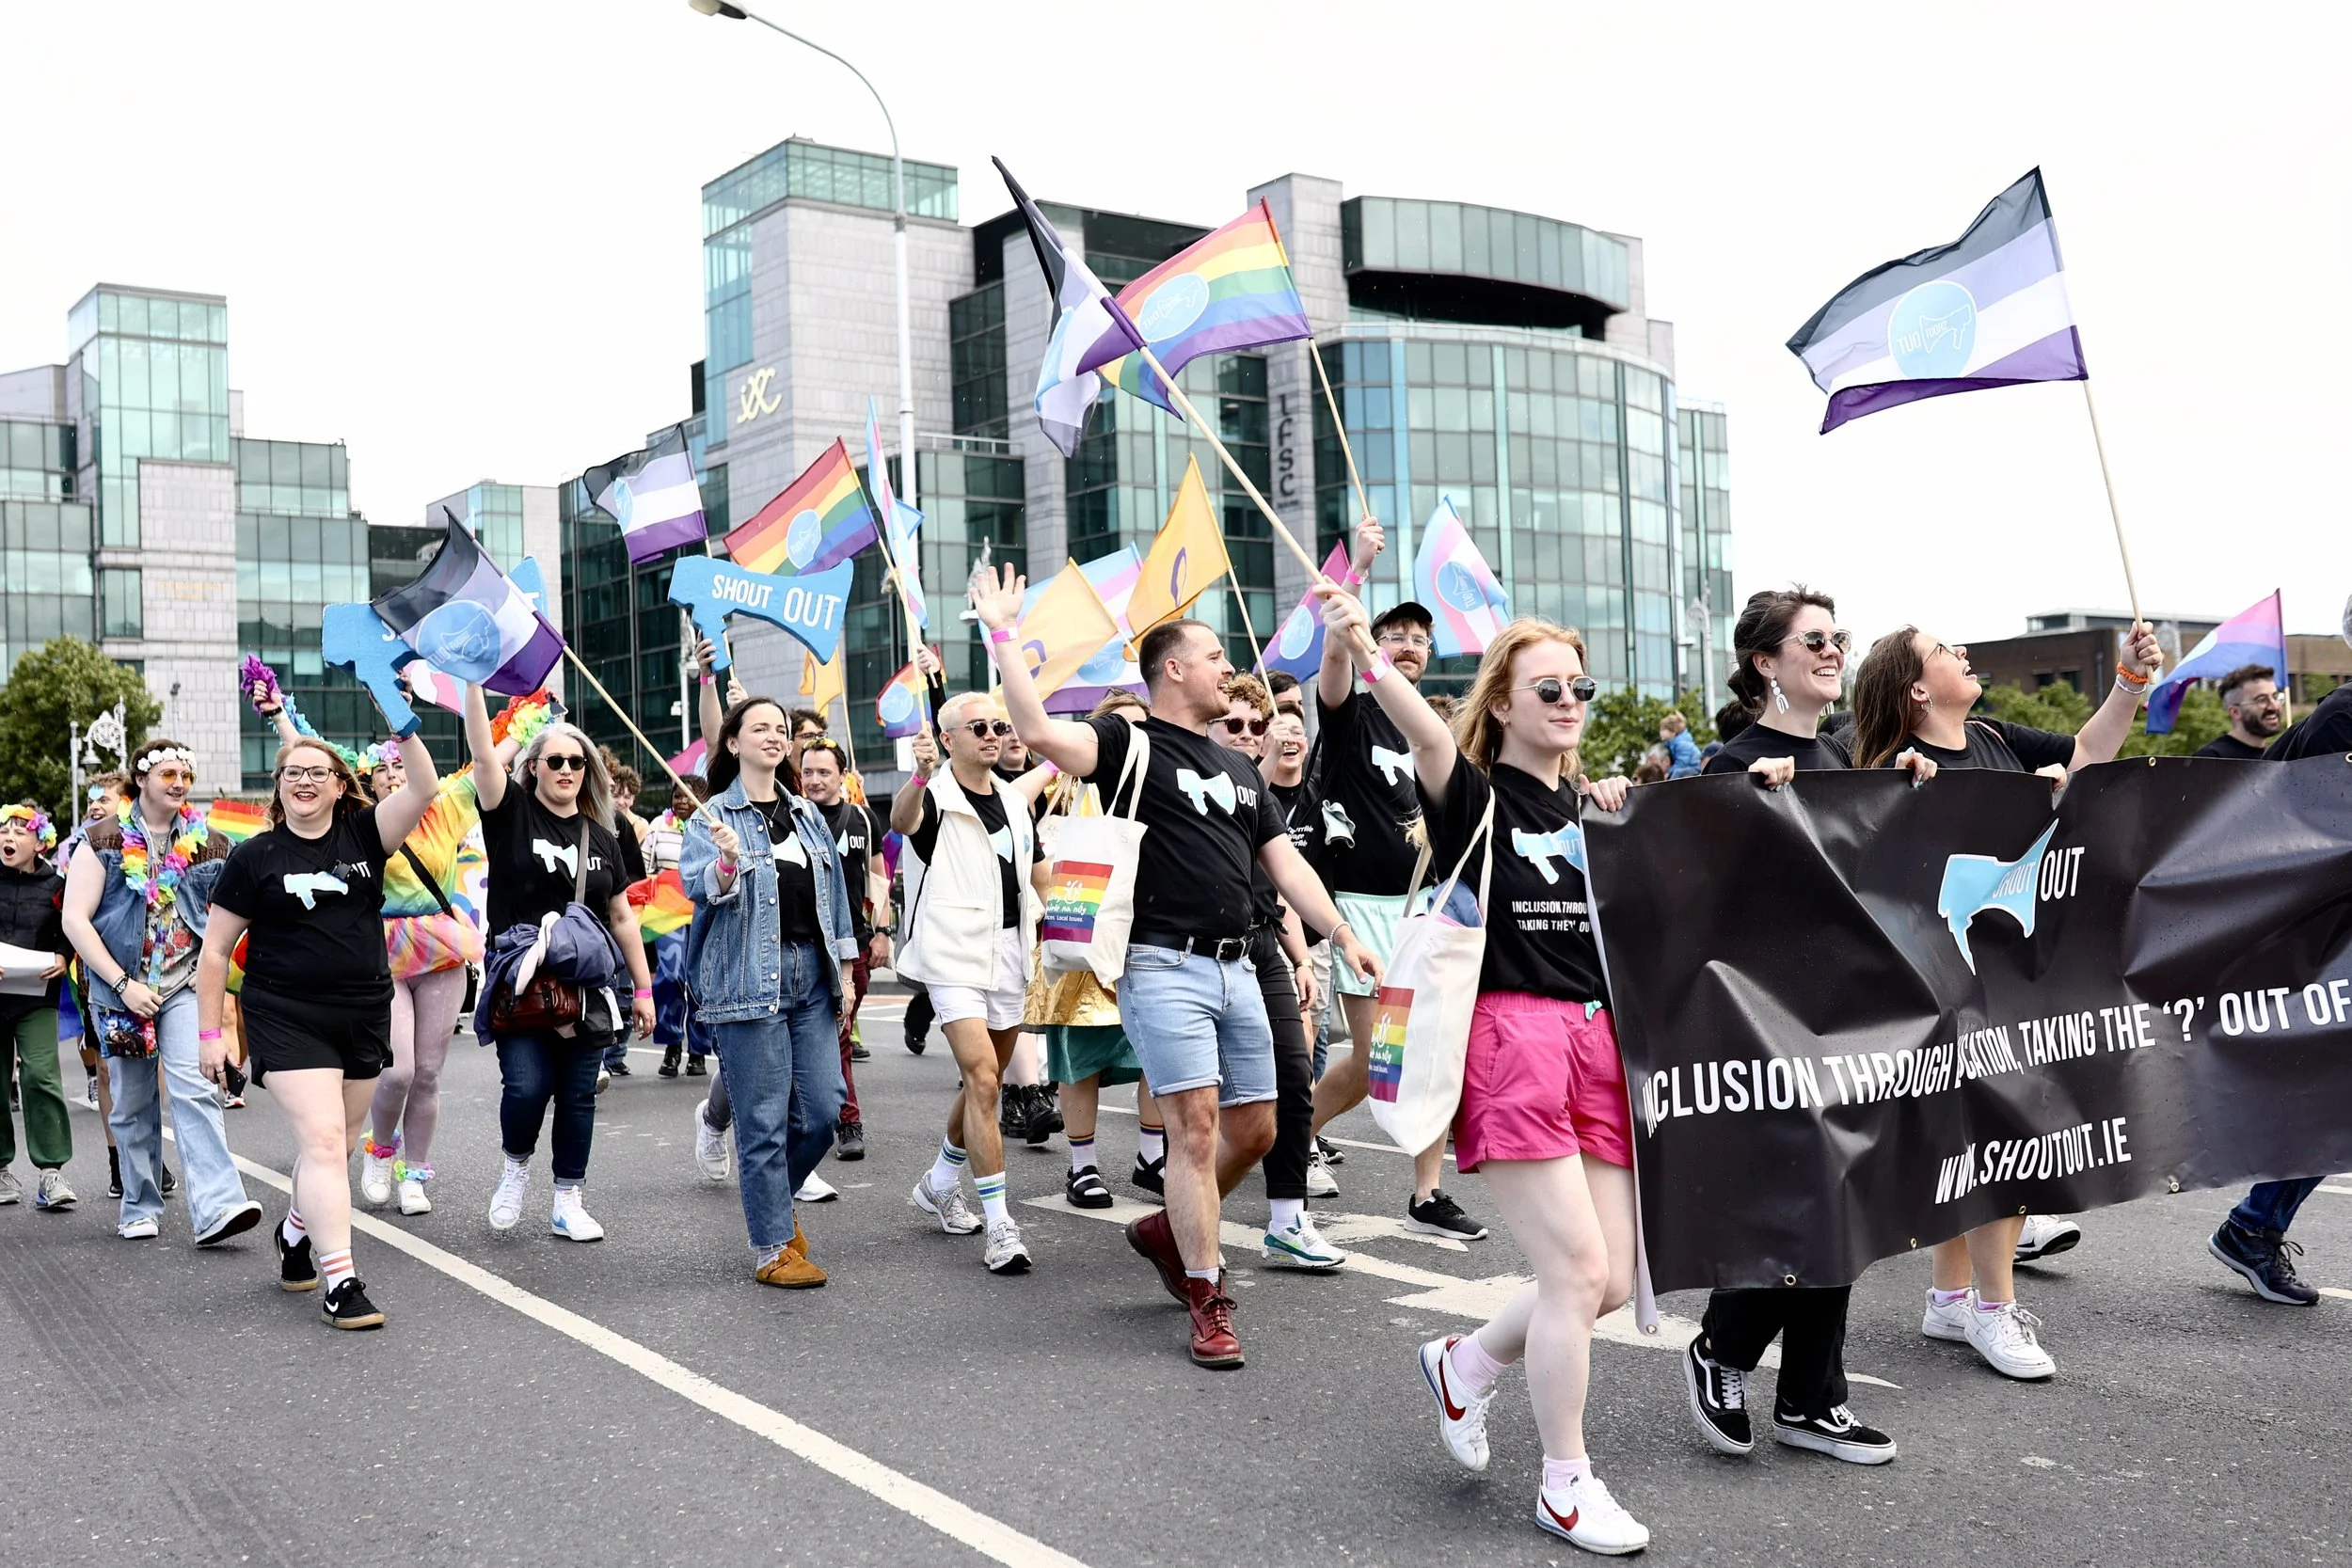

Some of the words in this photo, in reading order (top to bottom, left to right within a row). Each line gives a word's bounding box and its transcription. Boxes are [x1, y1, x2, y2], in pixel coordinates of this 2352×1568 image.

[710, 574, 773, 610] SHOUT
[782, 587, 842, 631] OUT
[1235, 784, 1258, 810] OUT
[849, 835, 866, 849] OUT
[586, 856, 601, 871] UT
[2040, 847, 2086, 902] OUT
[1517, 919, 1549, 931] TAKING
[1550, 920, 1569, 932] THE
[1579, 921, 1592, 933] OU
[1642, 1056, 1824, 1139] INCLUSION
[1821, 1042, 1954, 1106] THROUGH
[2018, 1010, 2097, 1068] TAKING
[2099, 1003, 2155, 1053] THE
[2218, 987, 2290, 1037] OUT
[2302, 978, 2352, 1027] OF
